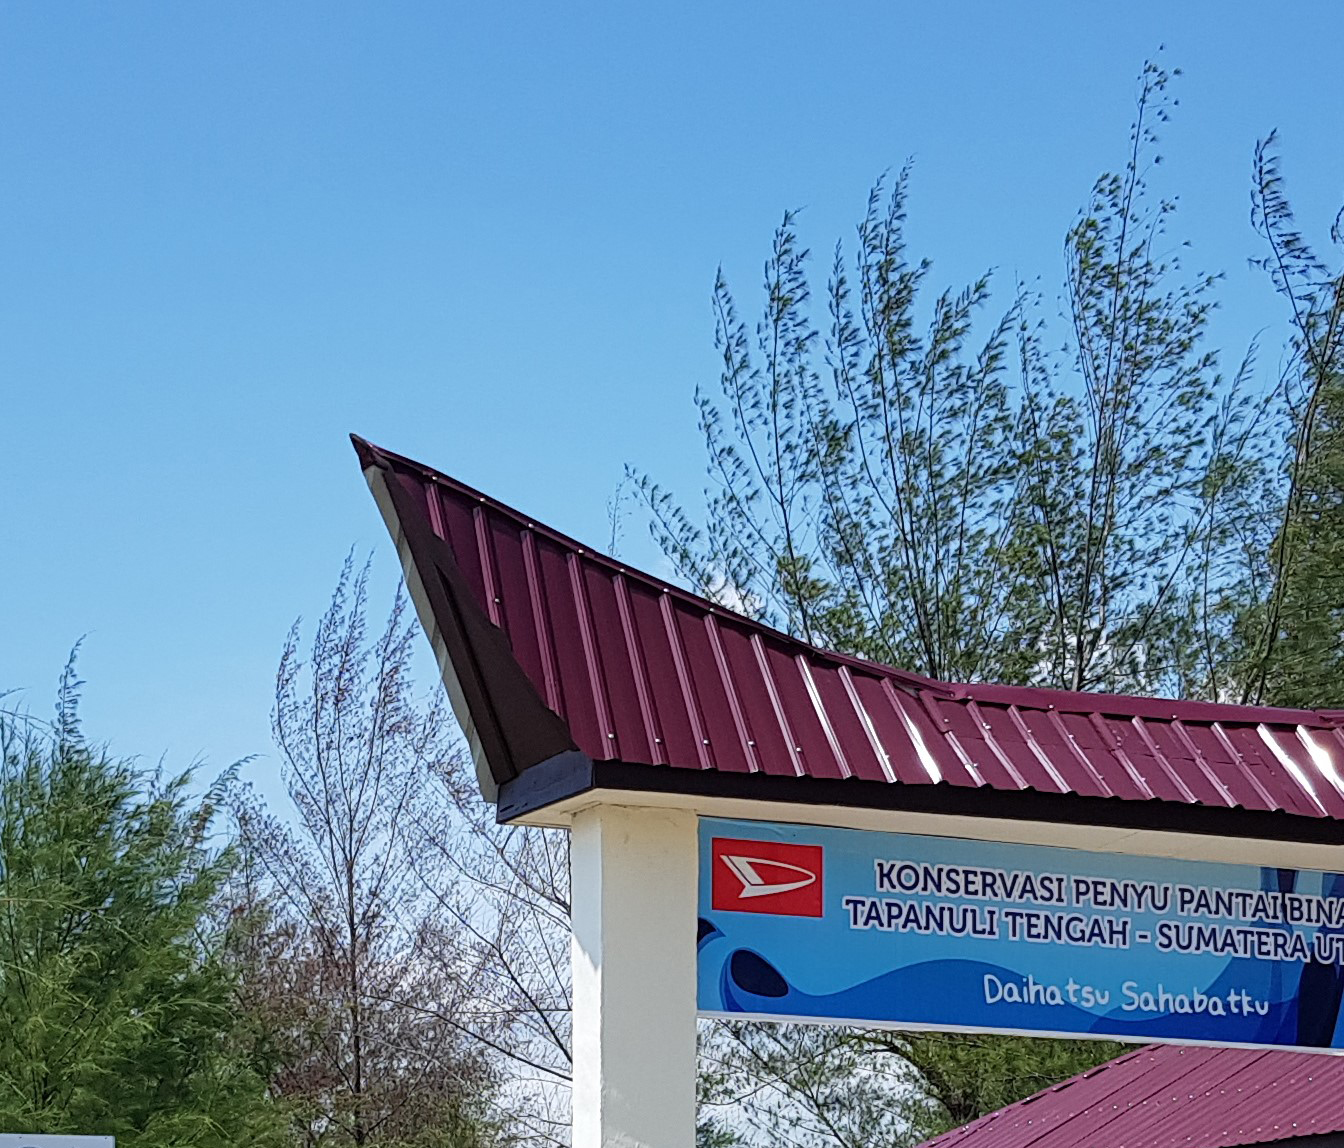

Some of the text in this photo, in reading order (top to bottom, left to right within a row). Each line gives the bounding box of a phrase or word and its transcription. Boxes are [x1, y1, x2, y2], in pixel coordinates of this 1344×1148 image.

[875, 859, 1067, 905] KONSERVASI
[1073, 879, 1172, 913] PENYU
[1179, 887, 1282, 922] PANTAI
[843, 899, 997, 937] TAPANULI
[1004, 913, 1129, 947] TENGAH
[1156, 924, 1312, 962] SUMATERA
[983, 972, 1270, 1016] Daihatsu Sahabatku
